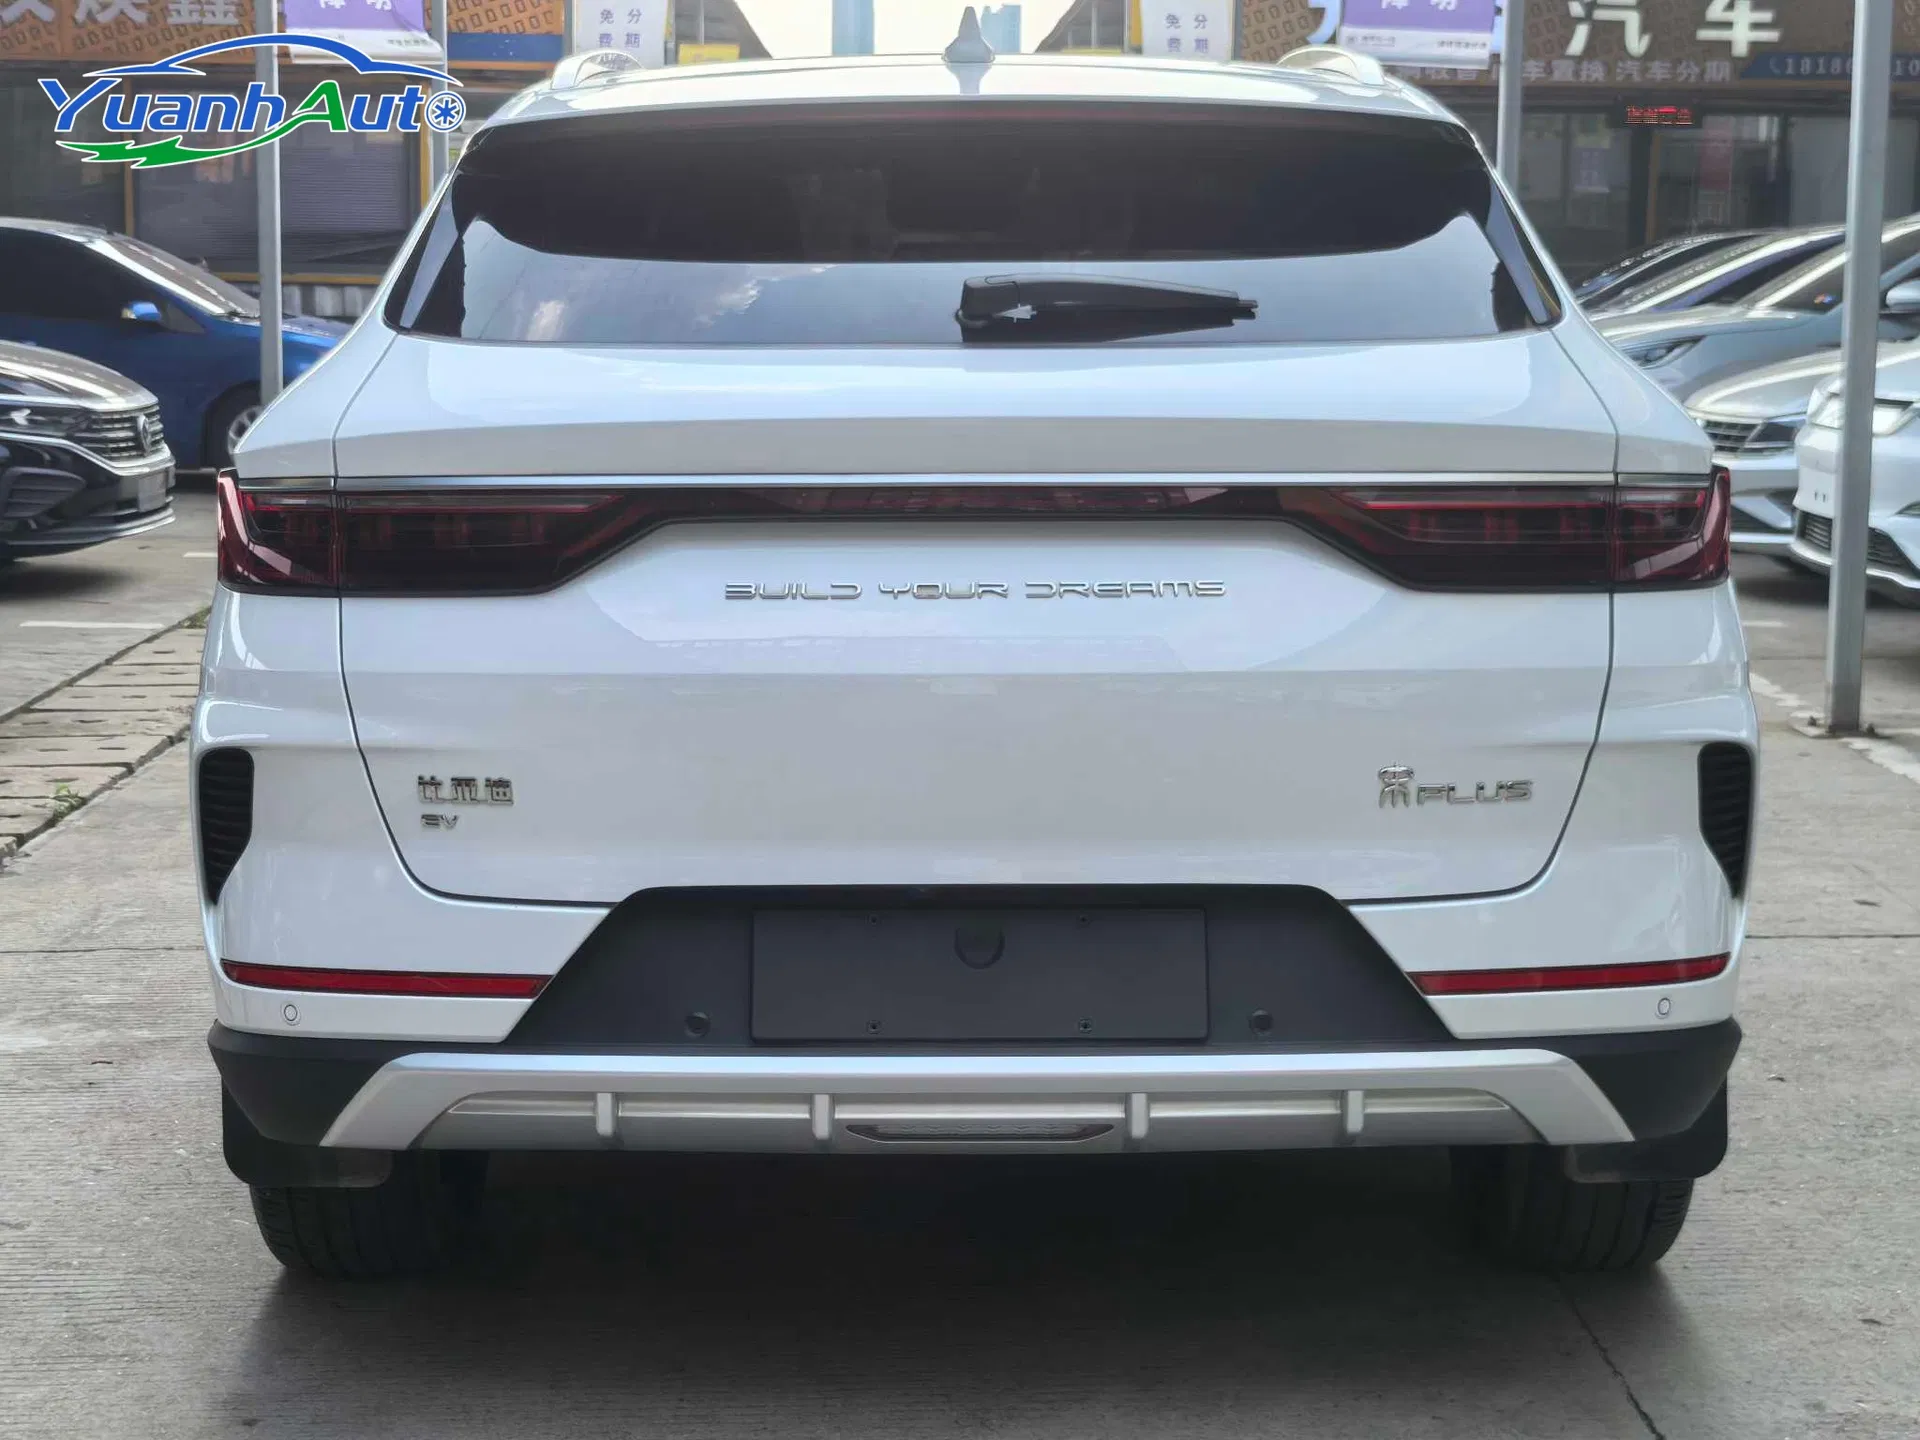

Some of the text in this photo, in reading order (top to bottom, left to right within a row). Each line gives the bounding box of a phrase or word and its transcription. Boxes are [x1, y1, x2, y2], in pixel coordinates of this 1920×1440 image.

[1565, 0, 1781, 58] 汽车
[1493, 59, 1606, 83] 车置换
[1615, 59, 1731, 83] 汽车分期
[725, 580, 1226, 601] BUILD YOUR DREAMS
[417, 775, 514, 806] 比亚迪
[1416, 779, 1533, 806] PLUS
[420, 813, 459, 829] EV
